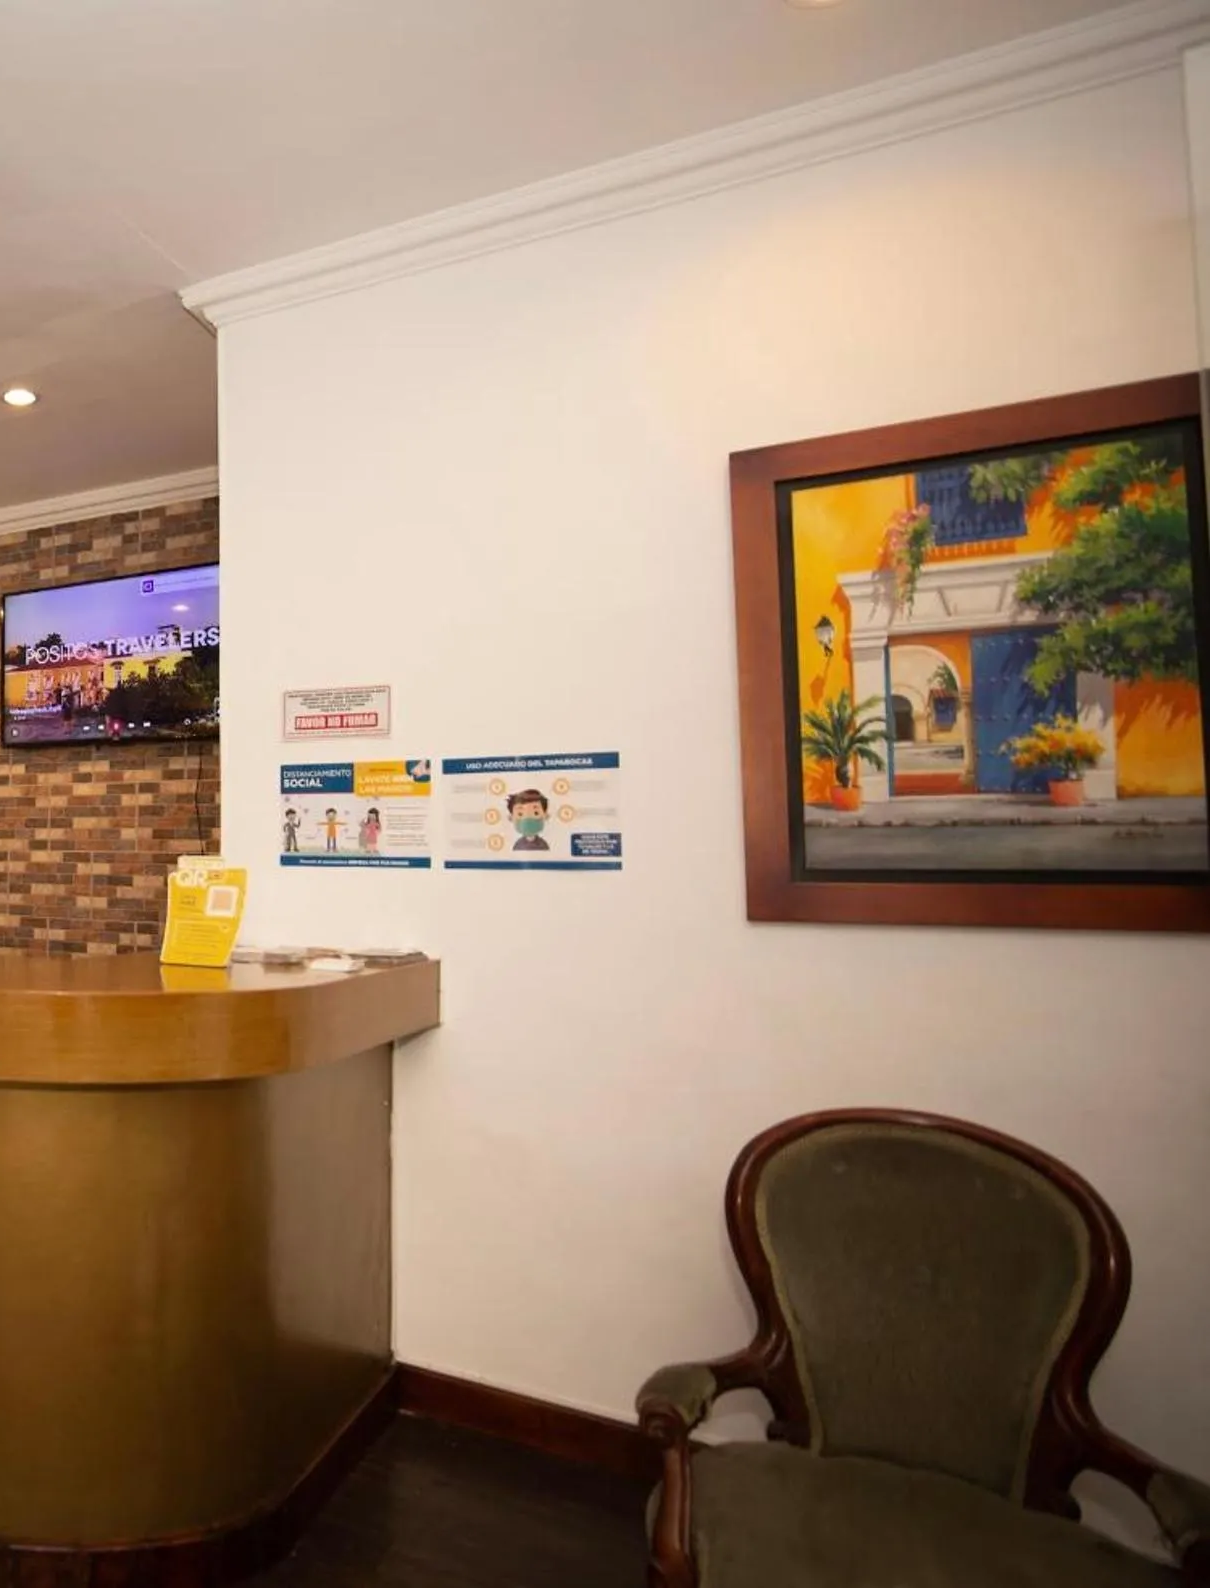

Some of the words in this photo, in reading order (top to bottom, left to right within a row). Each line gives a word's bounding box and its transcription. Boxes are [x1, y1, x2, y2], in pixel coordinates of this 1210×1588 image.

[104, 627, 220, 655] TRAVELERS
[297, 716, 325, 728] FAVOR
[327, 716, 340, 728] NO
[343, 714, 376, 726] FUMAR
[483, 760, 526, 769] ADECUADO
[545, 758, 593, 767] TAPABOCAS
[283, 769, 352, 779] DISTANCIAMIENTO
[283, 778, 323, 788] SOCIAL
